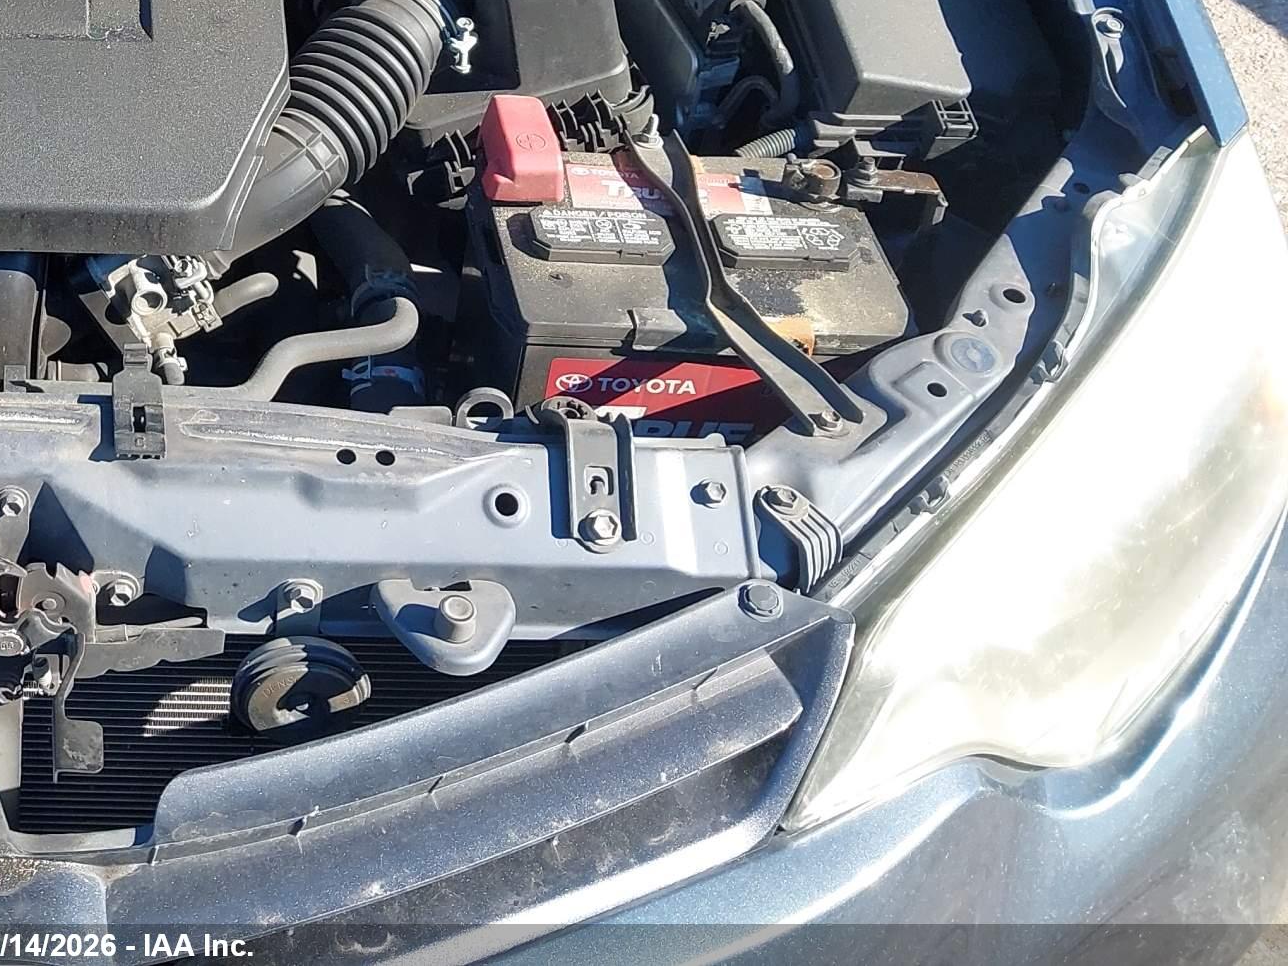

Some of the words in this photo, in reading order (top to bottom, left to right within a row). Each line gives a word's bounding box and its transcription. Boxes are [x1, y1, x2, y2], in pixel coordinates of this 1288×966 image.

[553, 209, 597, 218] DANGER
[607, 211, 648, 219] POISON
[598, 377, 697, 395] TOYOTA
